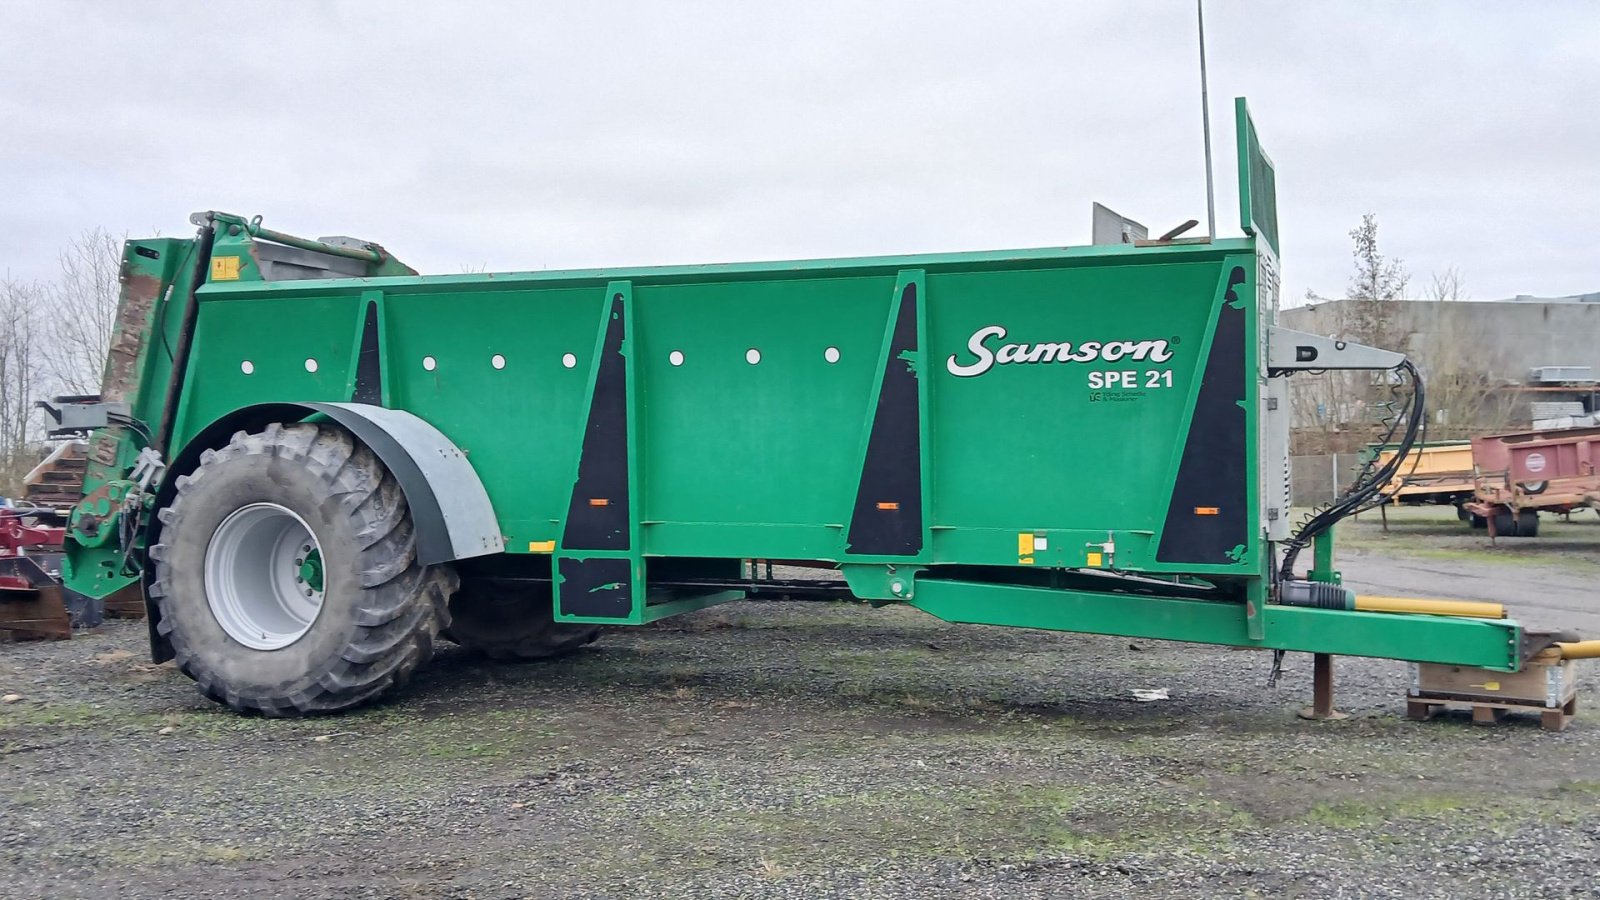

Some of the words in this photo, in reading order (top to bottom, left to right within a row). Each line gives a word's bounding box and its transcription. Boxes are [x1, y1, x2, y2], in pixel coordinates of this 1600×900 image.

[946, 325, 1174, 378] Samson
[1087, 370, 1138, 389] SPE
[1144, 369, 1173, 388] 21
